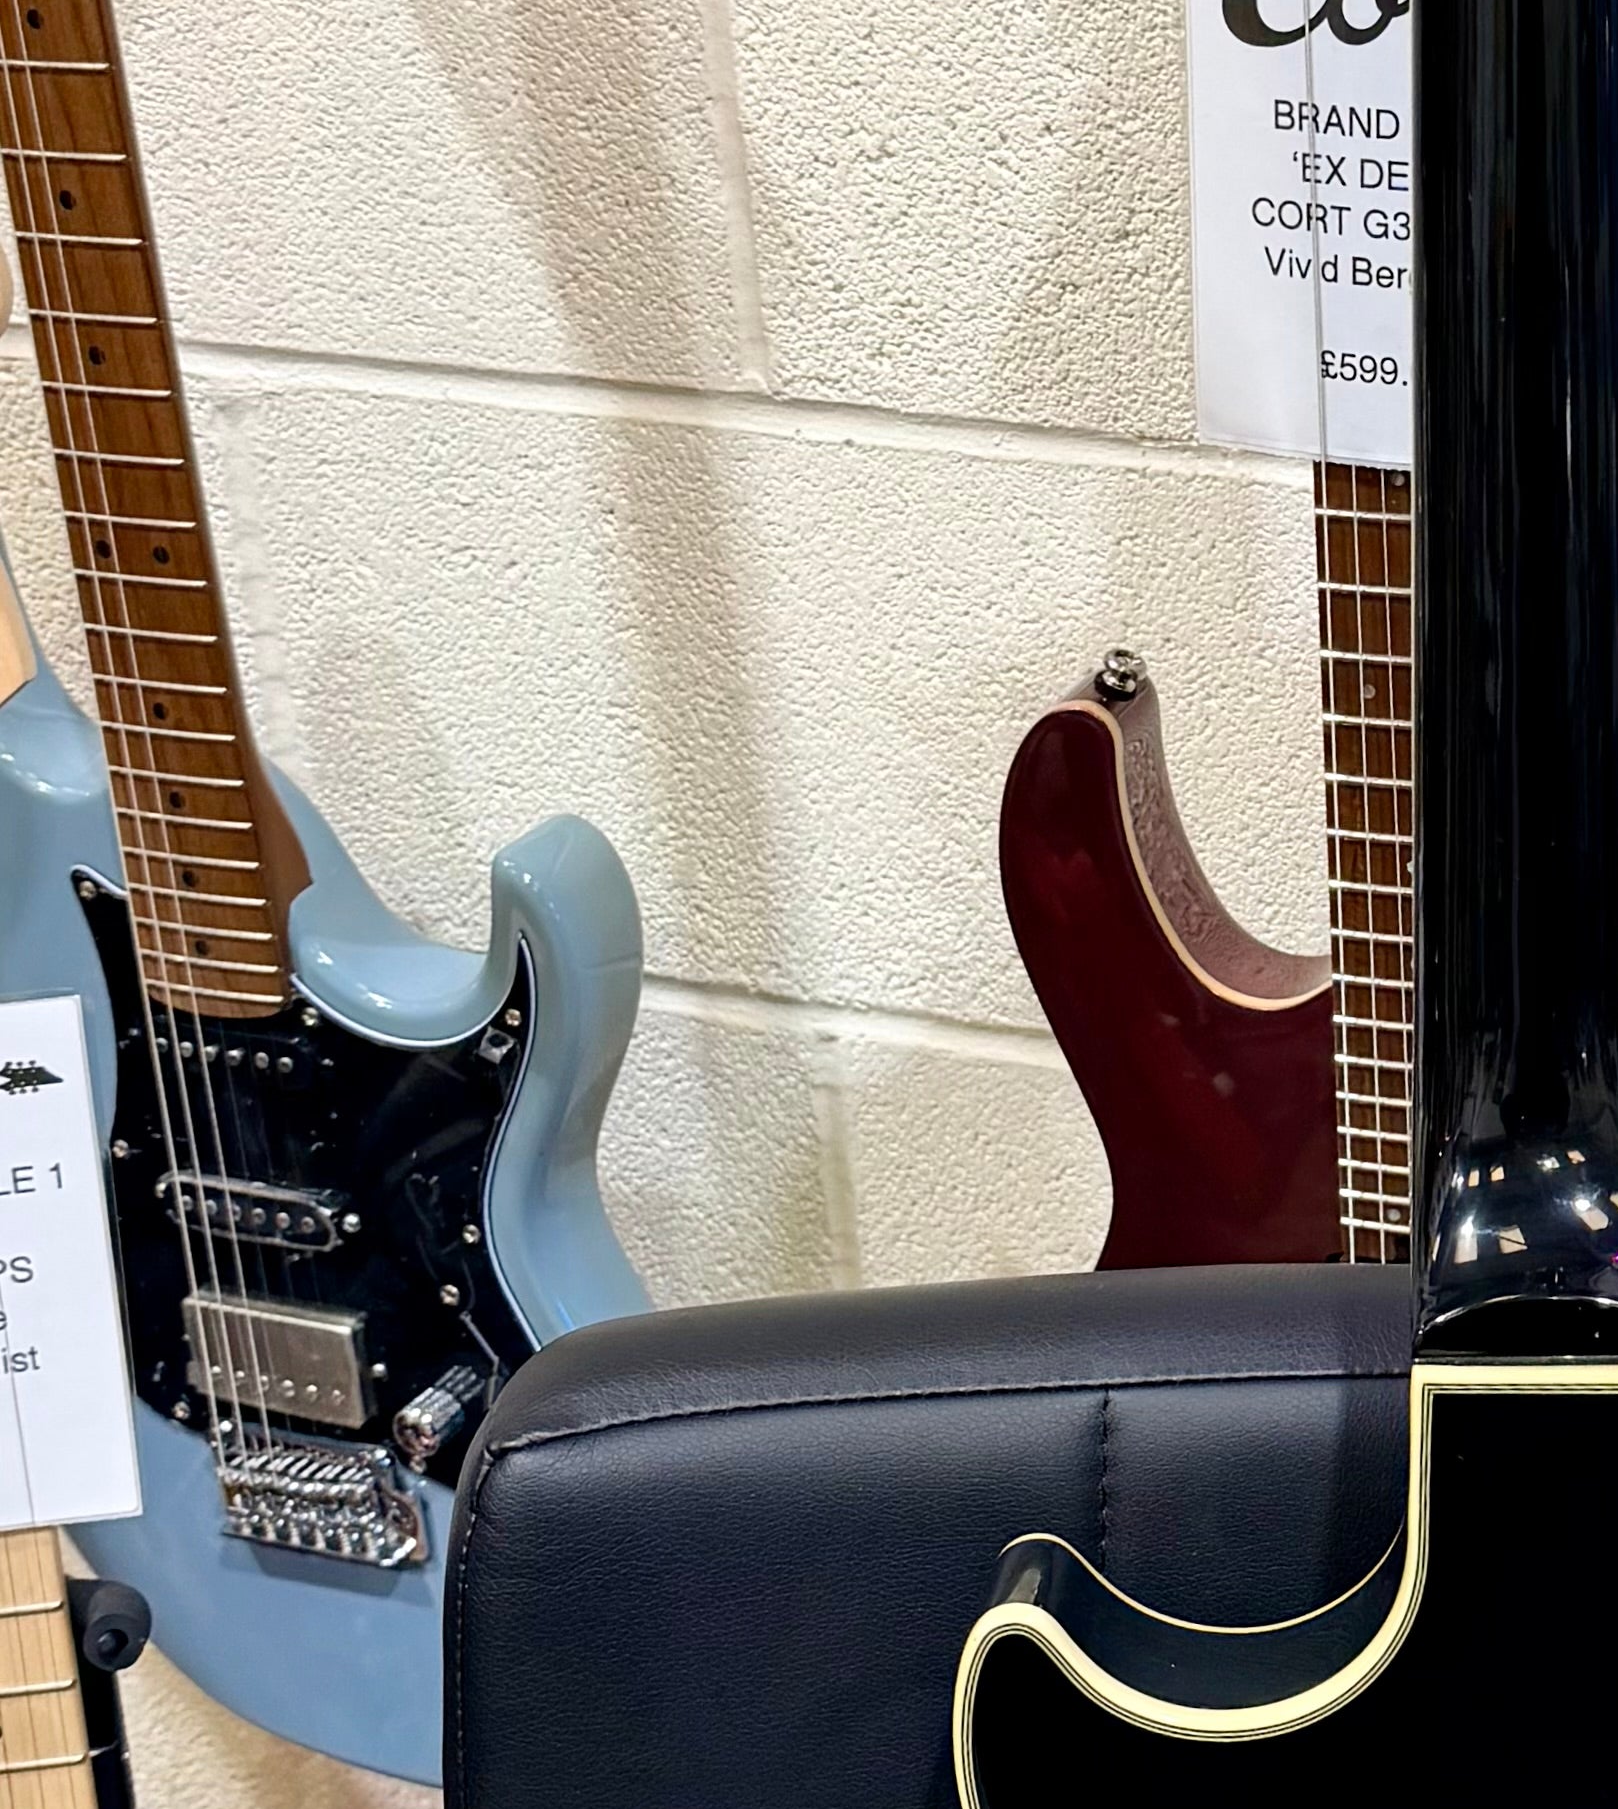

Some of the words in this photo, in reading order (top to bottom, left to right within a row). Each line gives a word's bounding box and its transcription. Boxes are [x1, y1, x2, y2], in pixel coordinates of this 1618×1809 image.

[1274, 99, 1400, 140] BRAND
[1252, 197, 1351, 235] CORT
[1264, 246, 1338, 283] Vivd
[49, 1161, 63, 1189] 1
